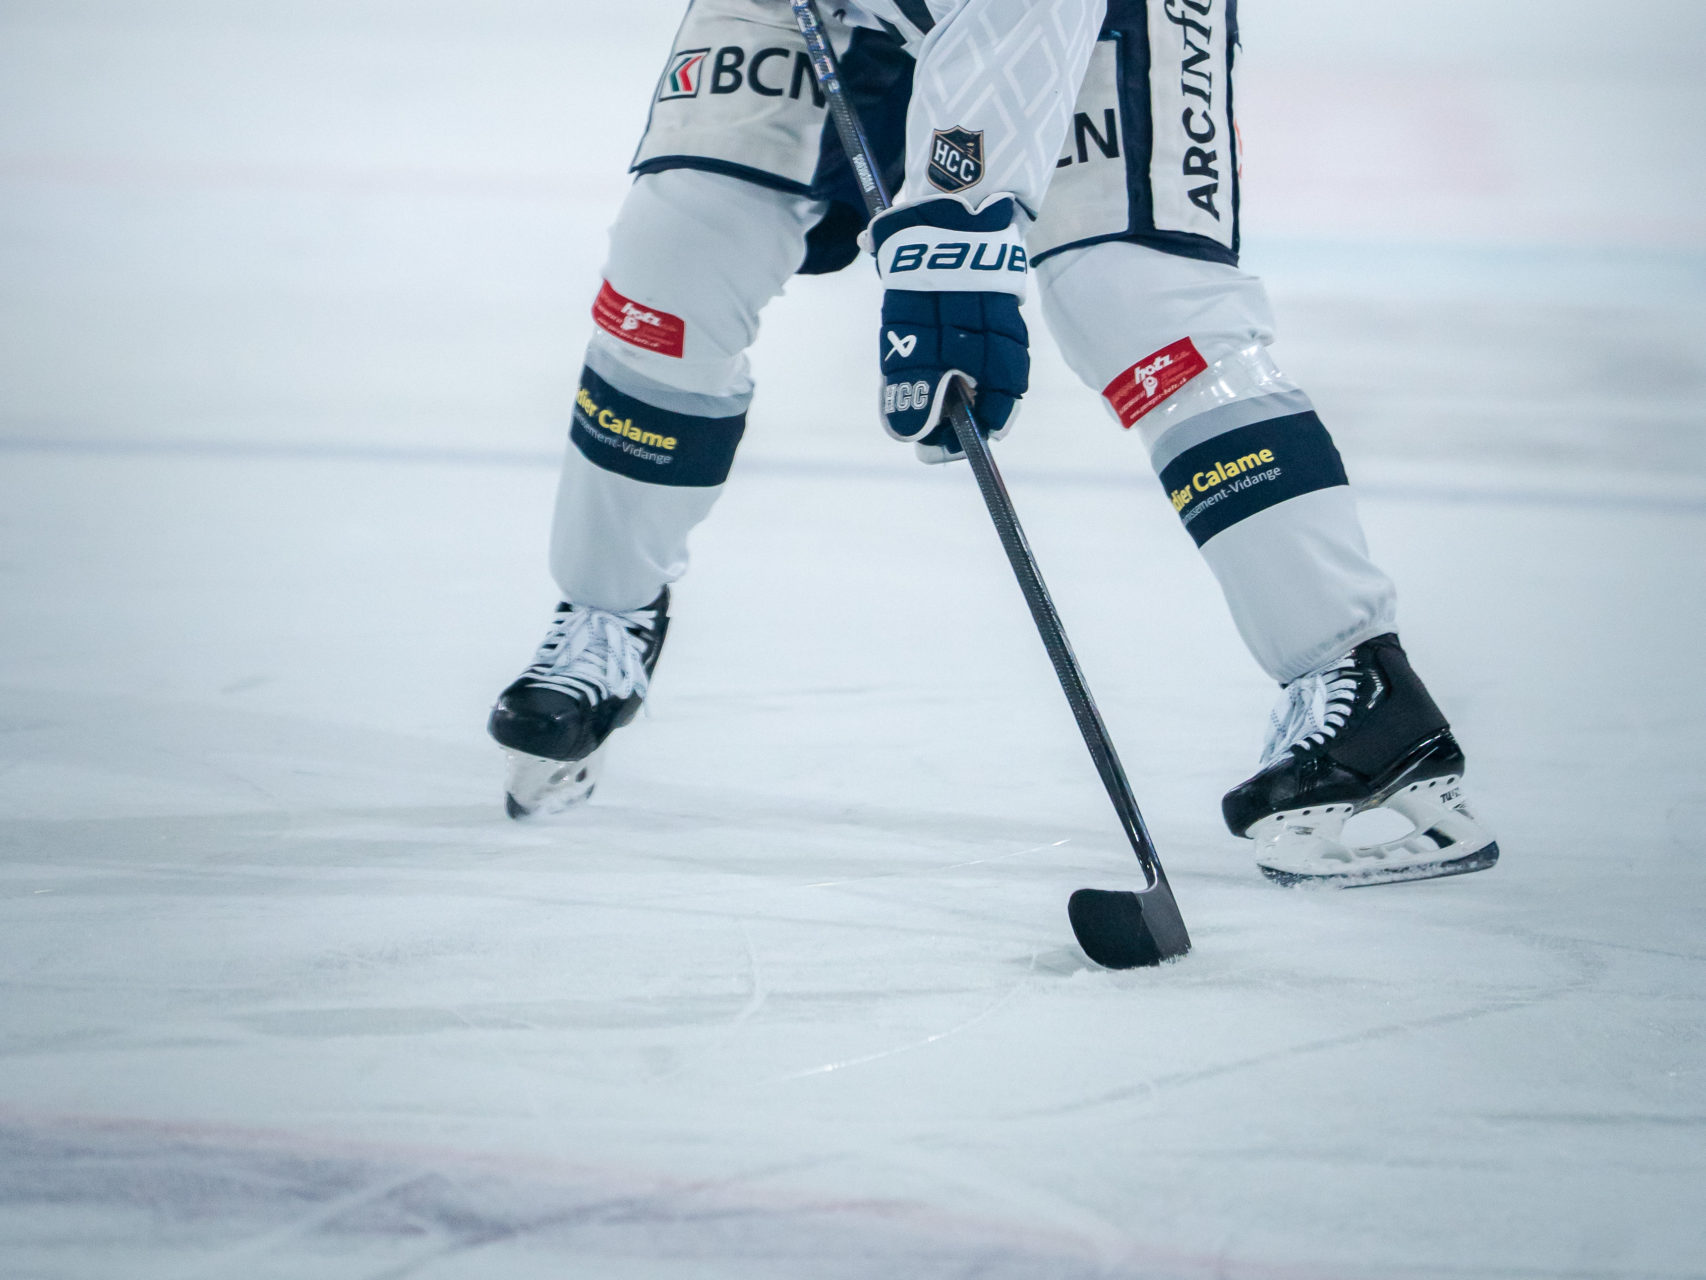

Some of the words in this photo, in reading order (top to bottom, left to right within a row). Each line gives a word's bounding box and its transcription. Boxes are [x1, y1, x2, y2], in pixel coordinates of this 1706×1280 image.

[710, 46, 826, 109] BCN
[934, 140, 975, 182] HCC
[889, 242, 1027, 274] BAUE
[1134, 354, 1173, 385] hotz
[885, 381, 930, 415] HCC
[598, 409, 677, 450] Calame
[1193, 448, 1275, 493] Calame
